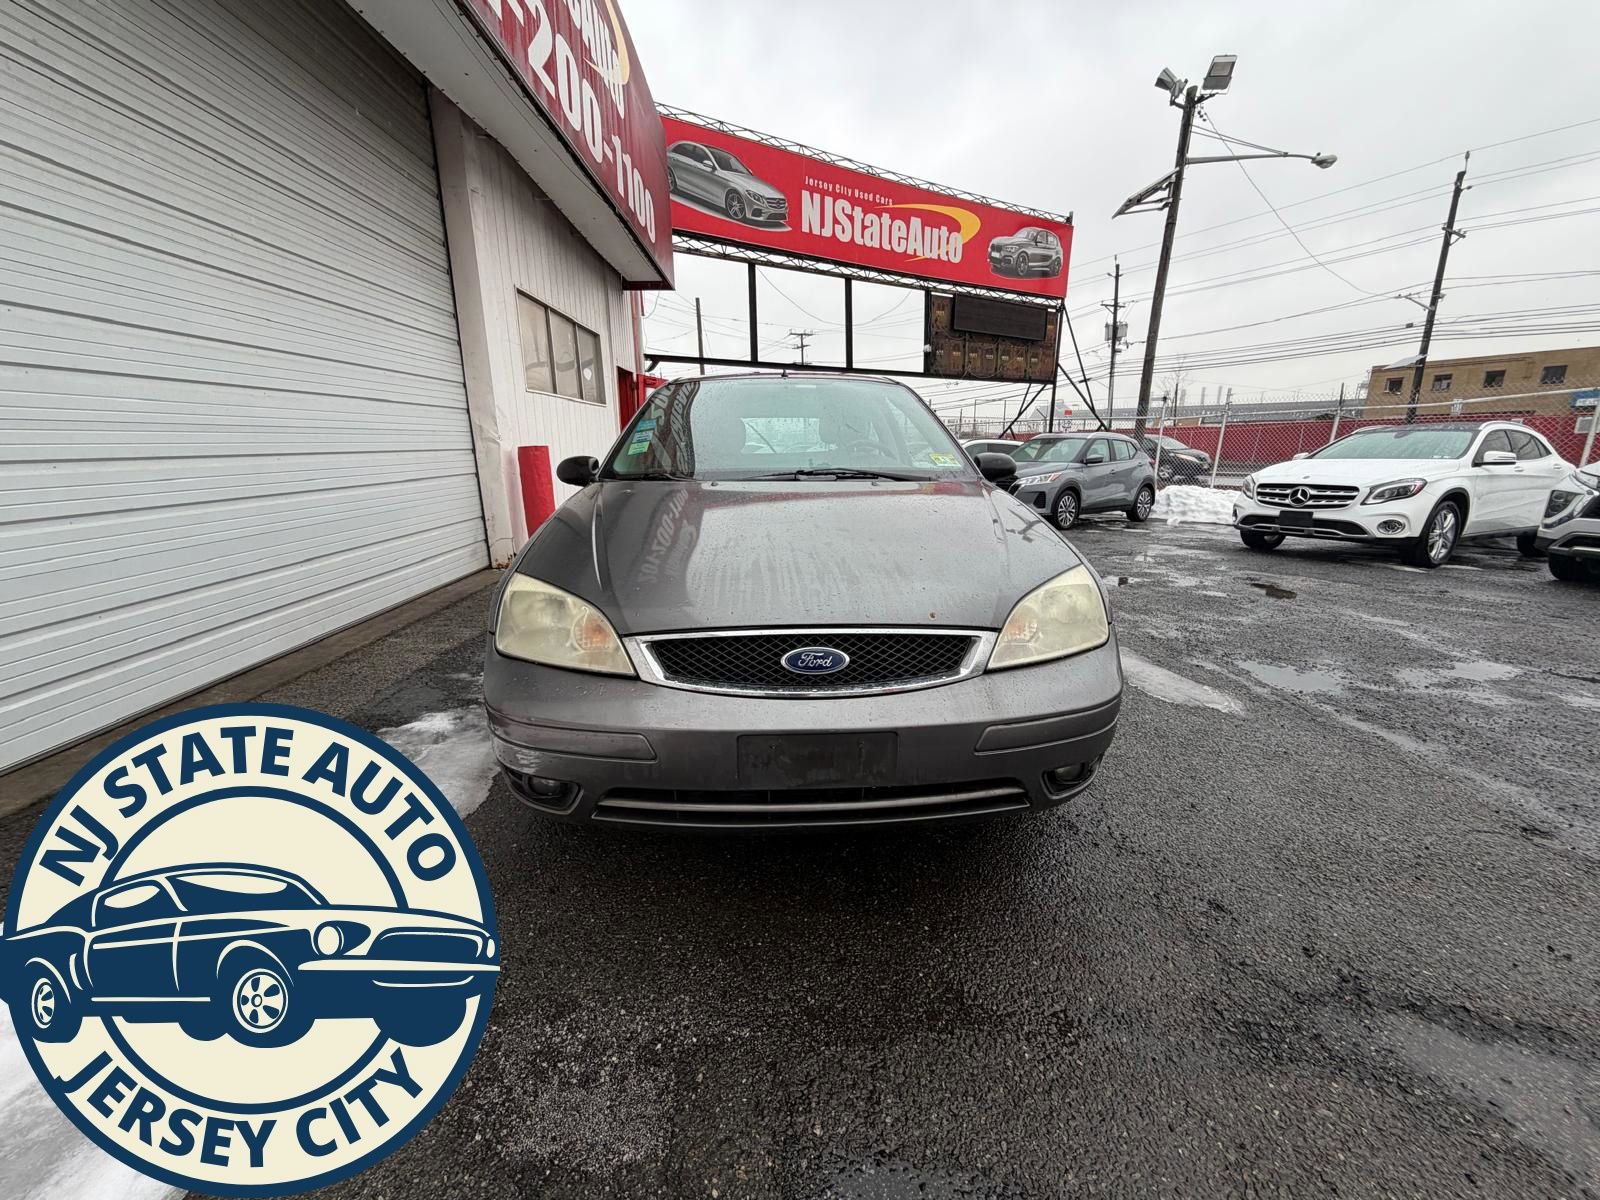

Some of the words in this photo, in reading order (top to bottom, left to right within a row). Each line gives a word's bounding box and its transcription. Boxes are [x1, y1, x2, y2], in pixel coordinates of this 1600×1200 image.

[805, 175, 833, 192] Jersey
[835, 183, 852, 197] City
[854, 188, 874, 202] Used
[875, 194, 893, 206] Cars
[801, 189, 963, 264] NJStateAuto
[798, 652, 833, 667] Ford
